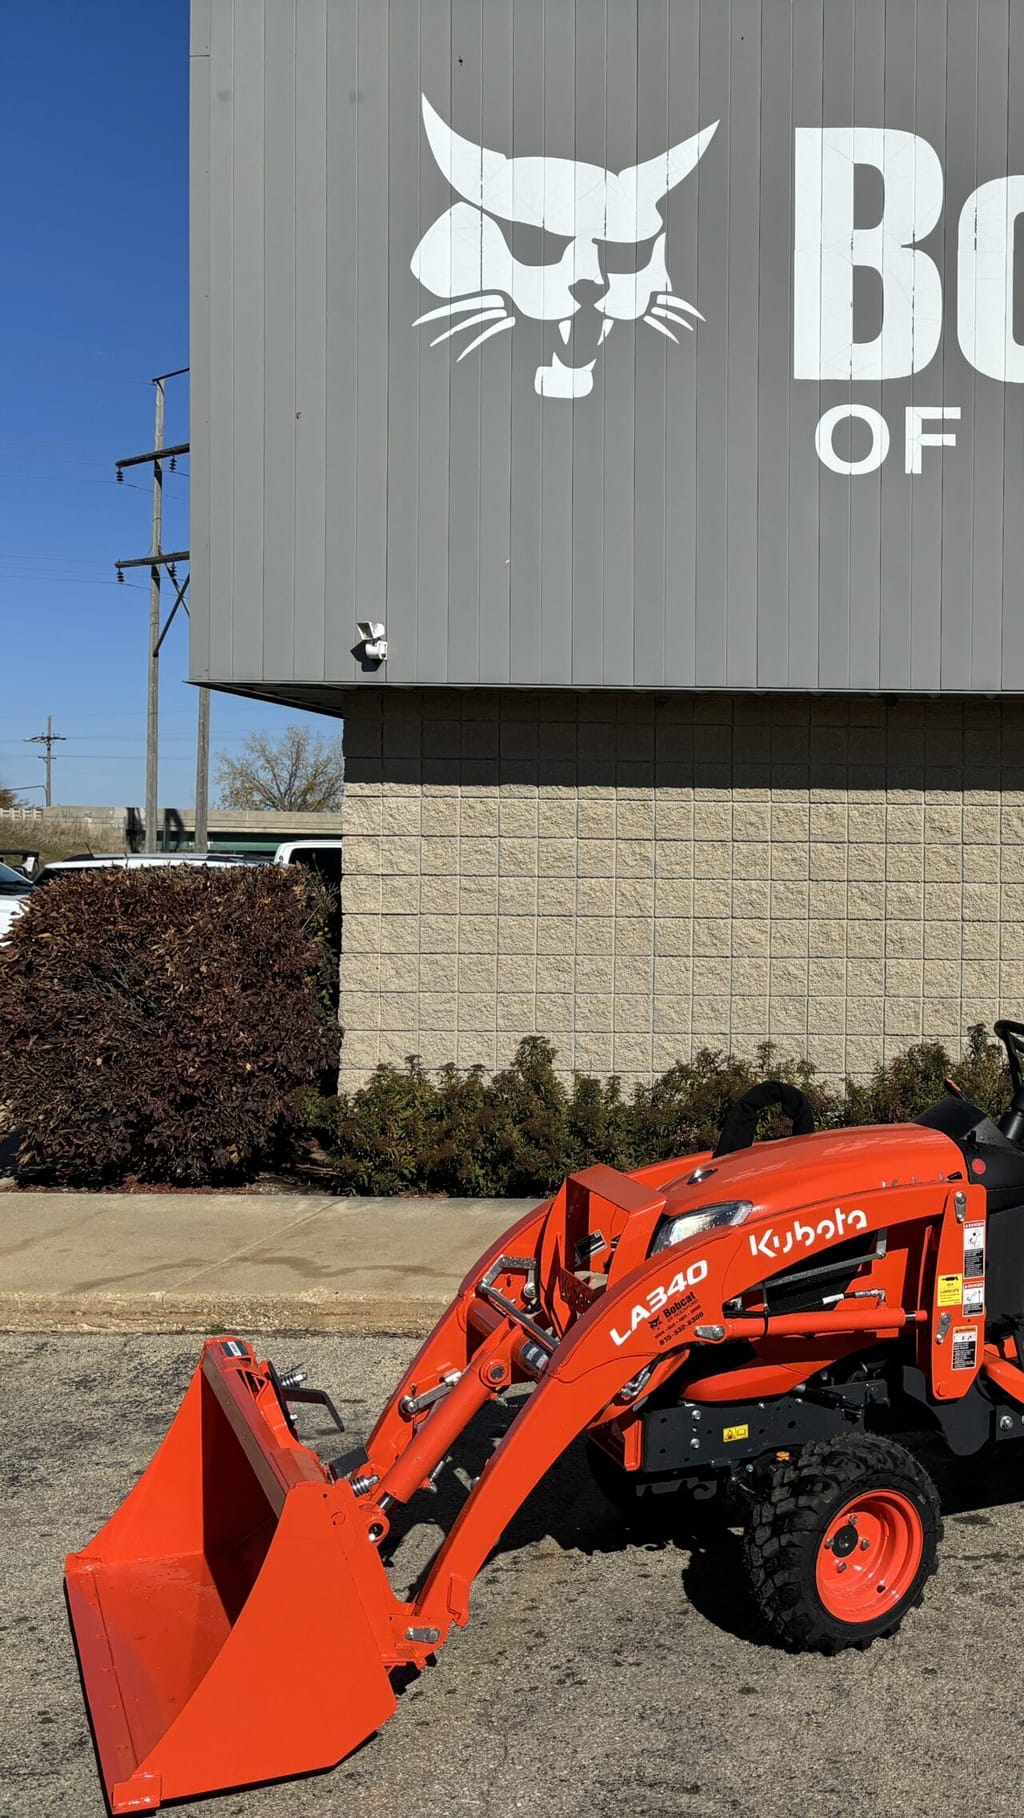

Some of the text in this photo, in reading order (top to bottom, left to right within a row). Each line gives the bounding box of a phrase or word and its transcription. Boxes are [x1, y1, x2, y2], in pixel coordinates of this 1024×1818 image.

[815, 404, 961, 475] OF
[748, 1207, 868, 1258] Kubota
[609, 1259, 708, 1346] LA340
[663, 1291, 696, 1318] Bobcat
